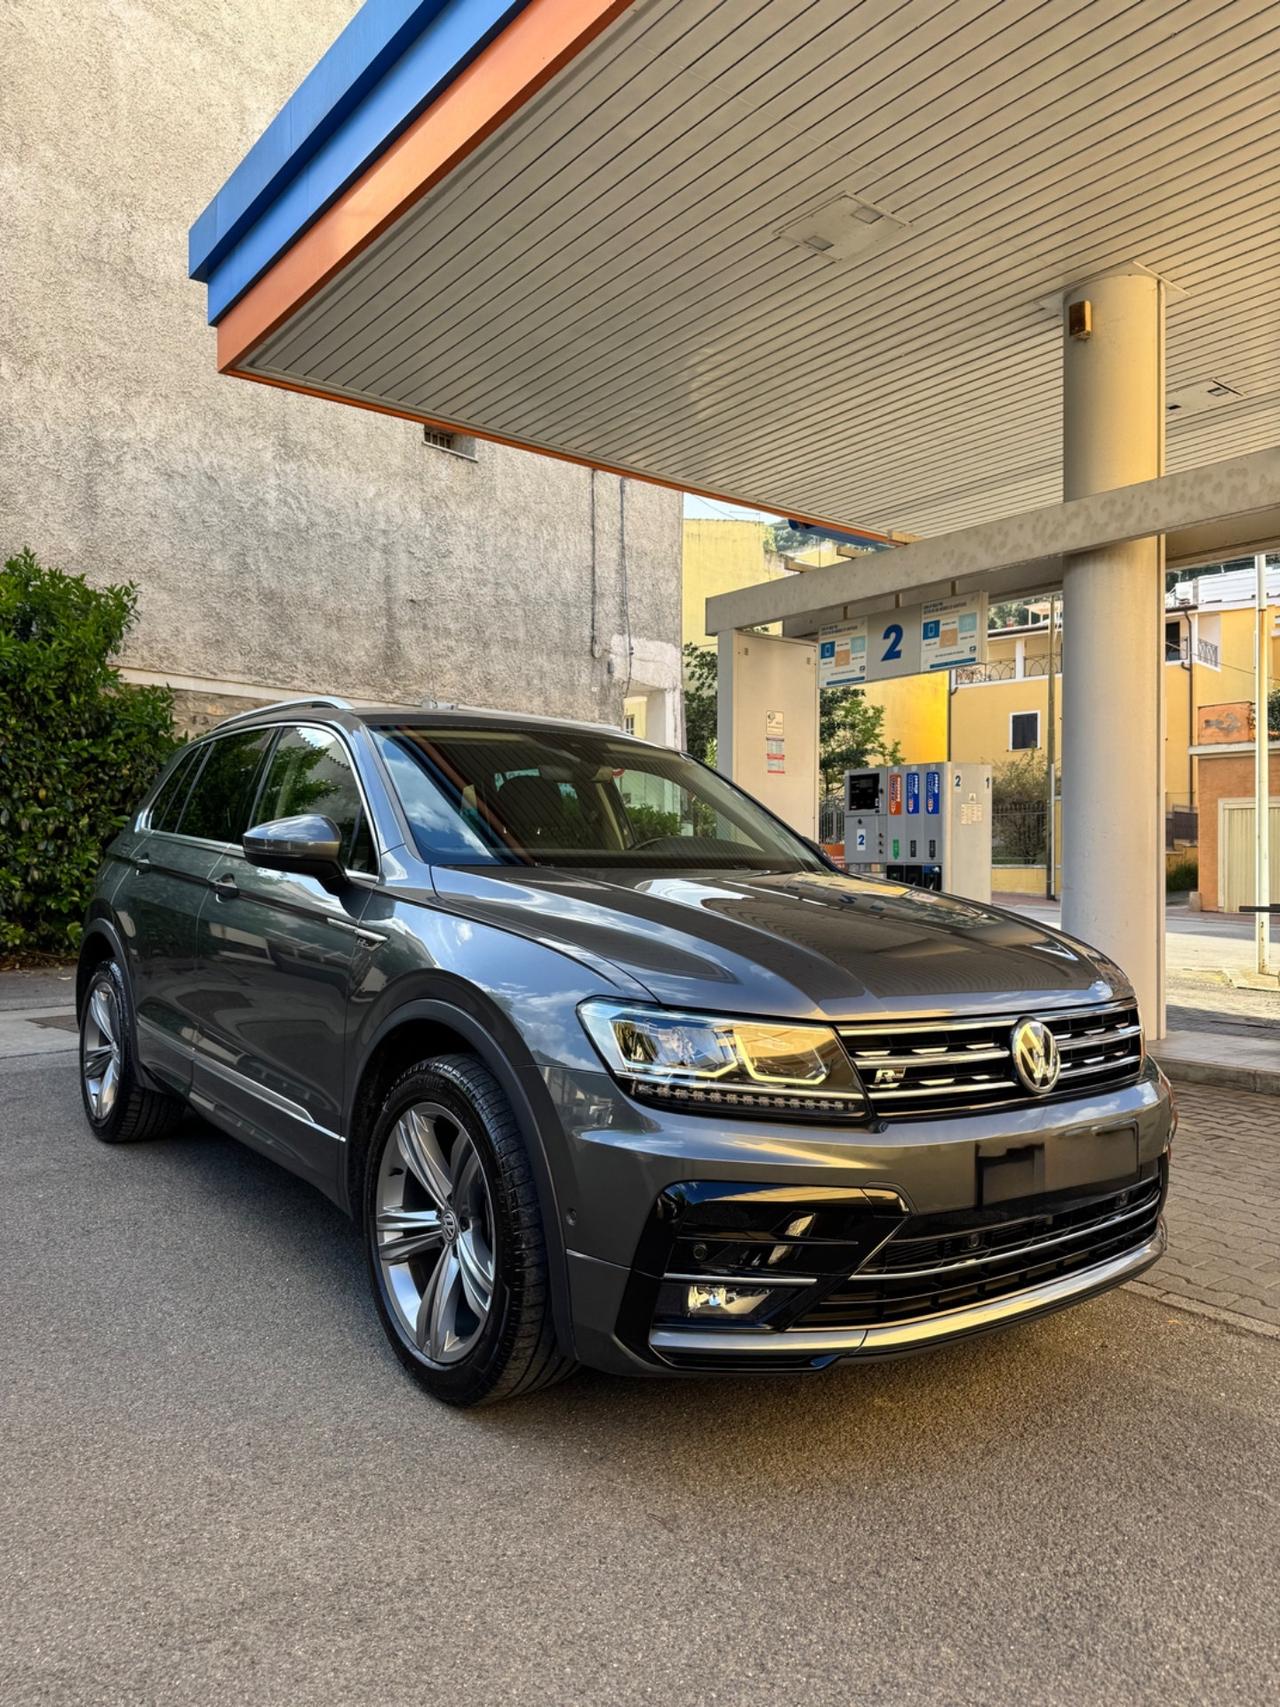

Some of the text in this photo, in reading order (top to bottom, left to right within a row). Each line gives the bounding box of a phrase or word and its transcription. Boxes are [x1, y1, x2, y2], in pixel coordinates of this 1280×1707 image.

[881, 623, 903, 662] 2
[955, 775, 961, 787] 2
[986, 776, 990, 789] 1
[858, 834, 865, 846] 2
